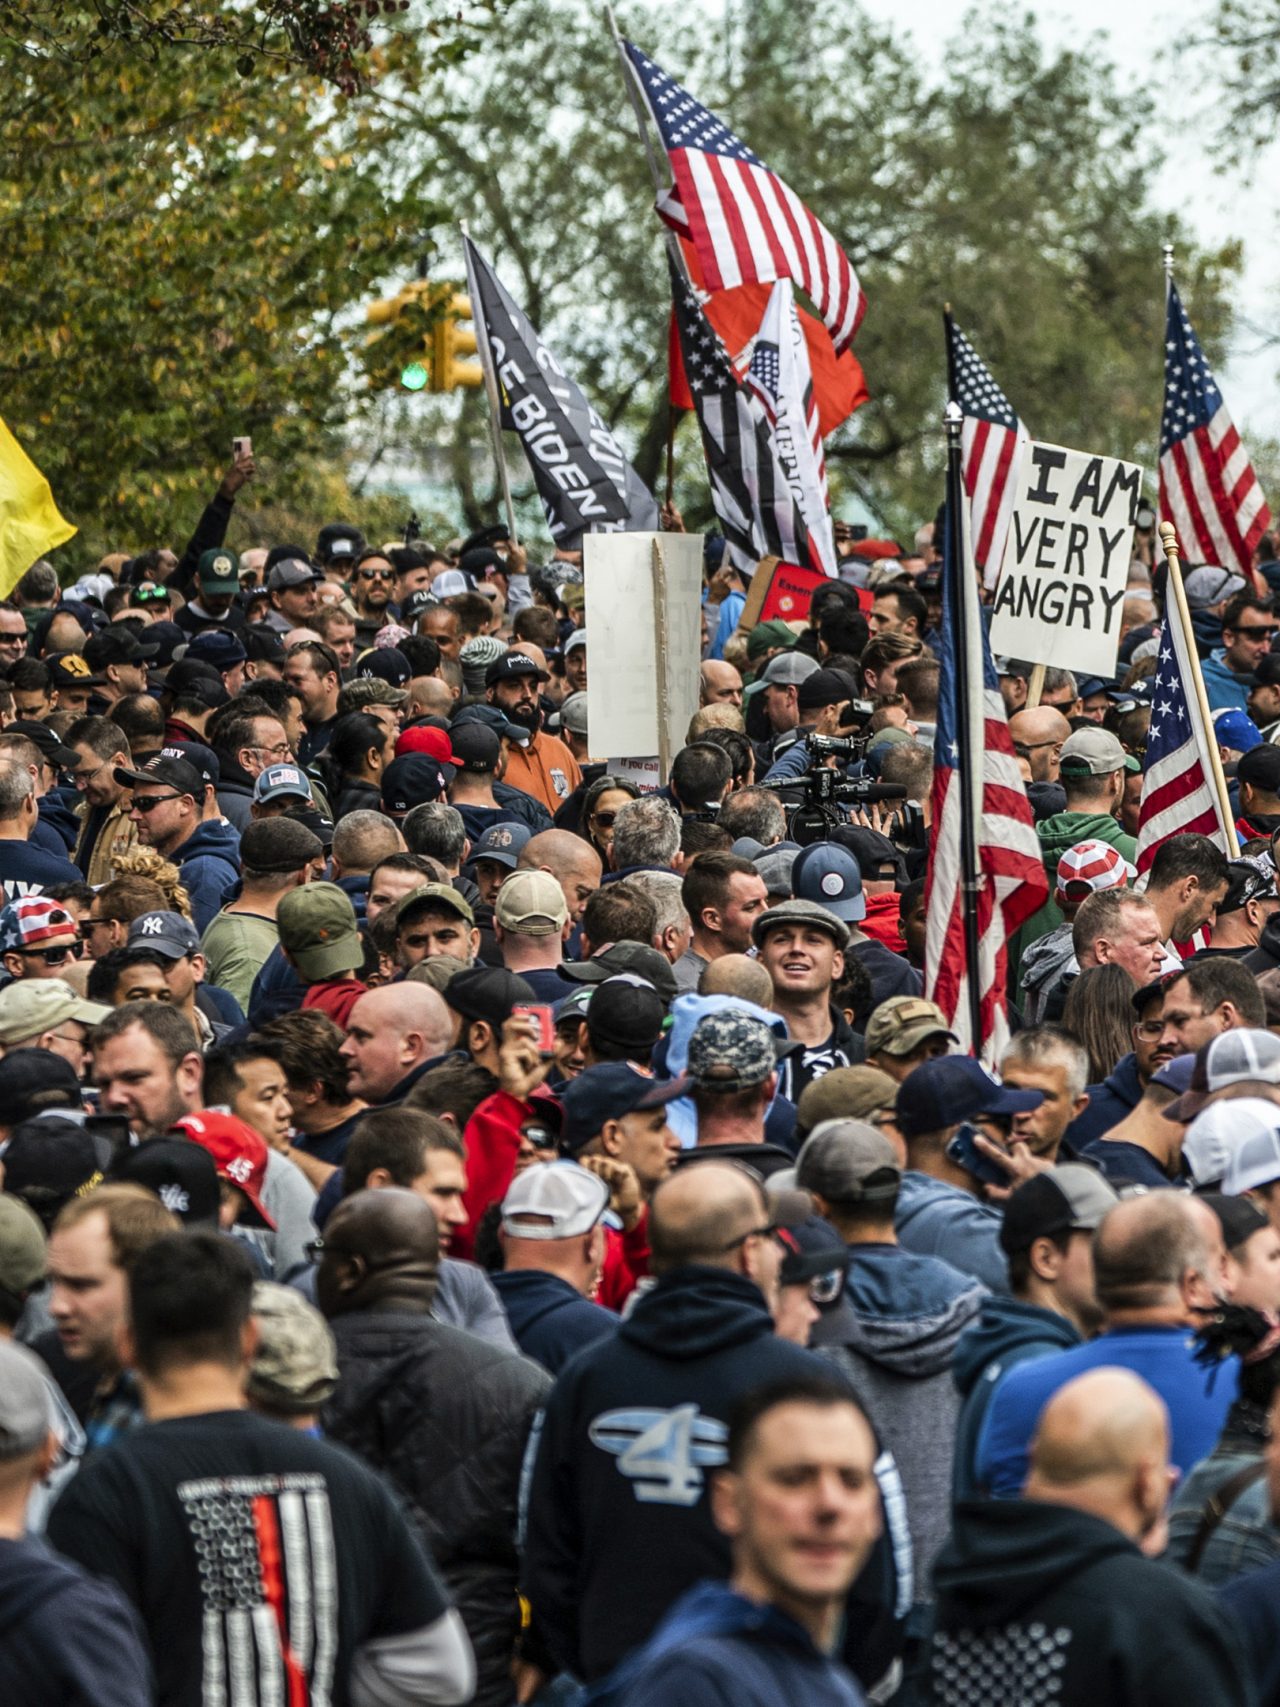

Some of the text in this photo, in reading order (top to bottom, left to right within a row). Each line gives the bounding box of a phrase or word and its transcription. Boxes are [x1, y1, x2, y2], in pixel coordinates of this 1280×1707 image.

[511, 393, 606, 517] BIDEN
[1027, 446, 1141, 526] I AM
[1013, 510, 1125, 579] VERY
[778, 578, 812, 597] Essen
[994, 574, 1124, 634] ANGRY
[629, 760, 643, 770] you
[644, 763, 659, 772] call
